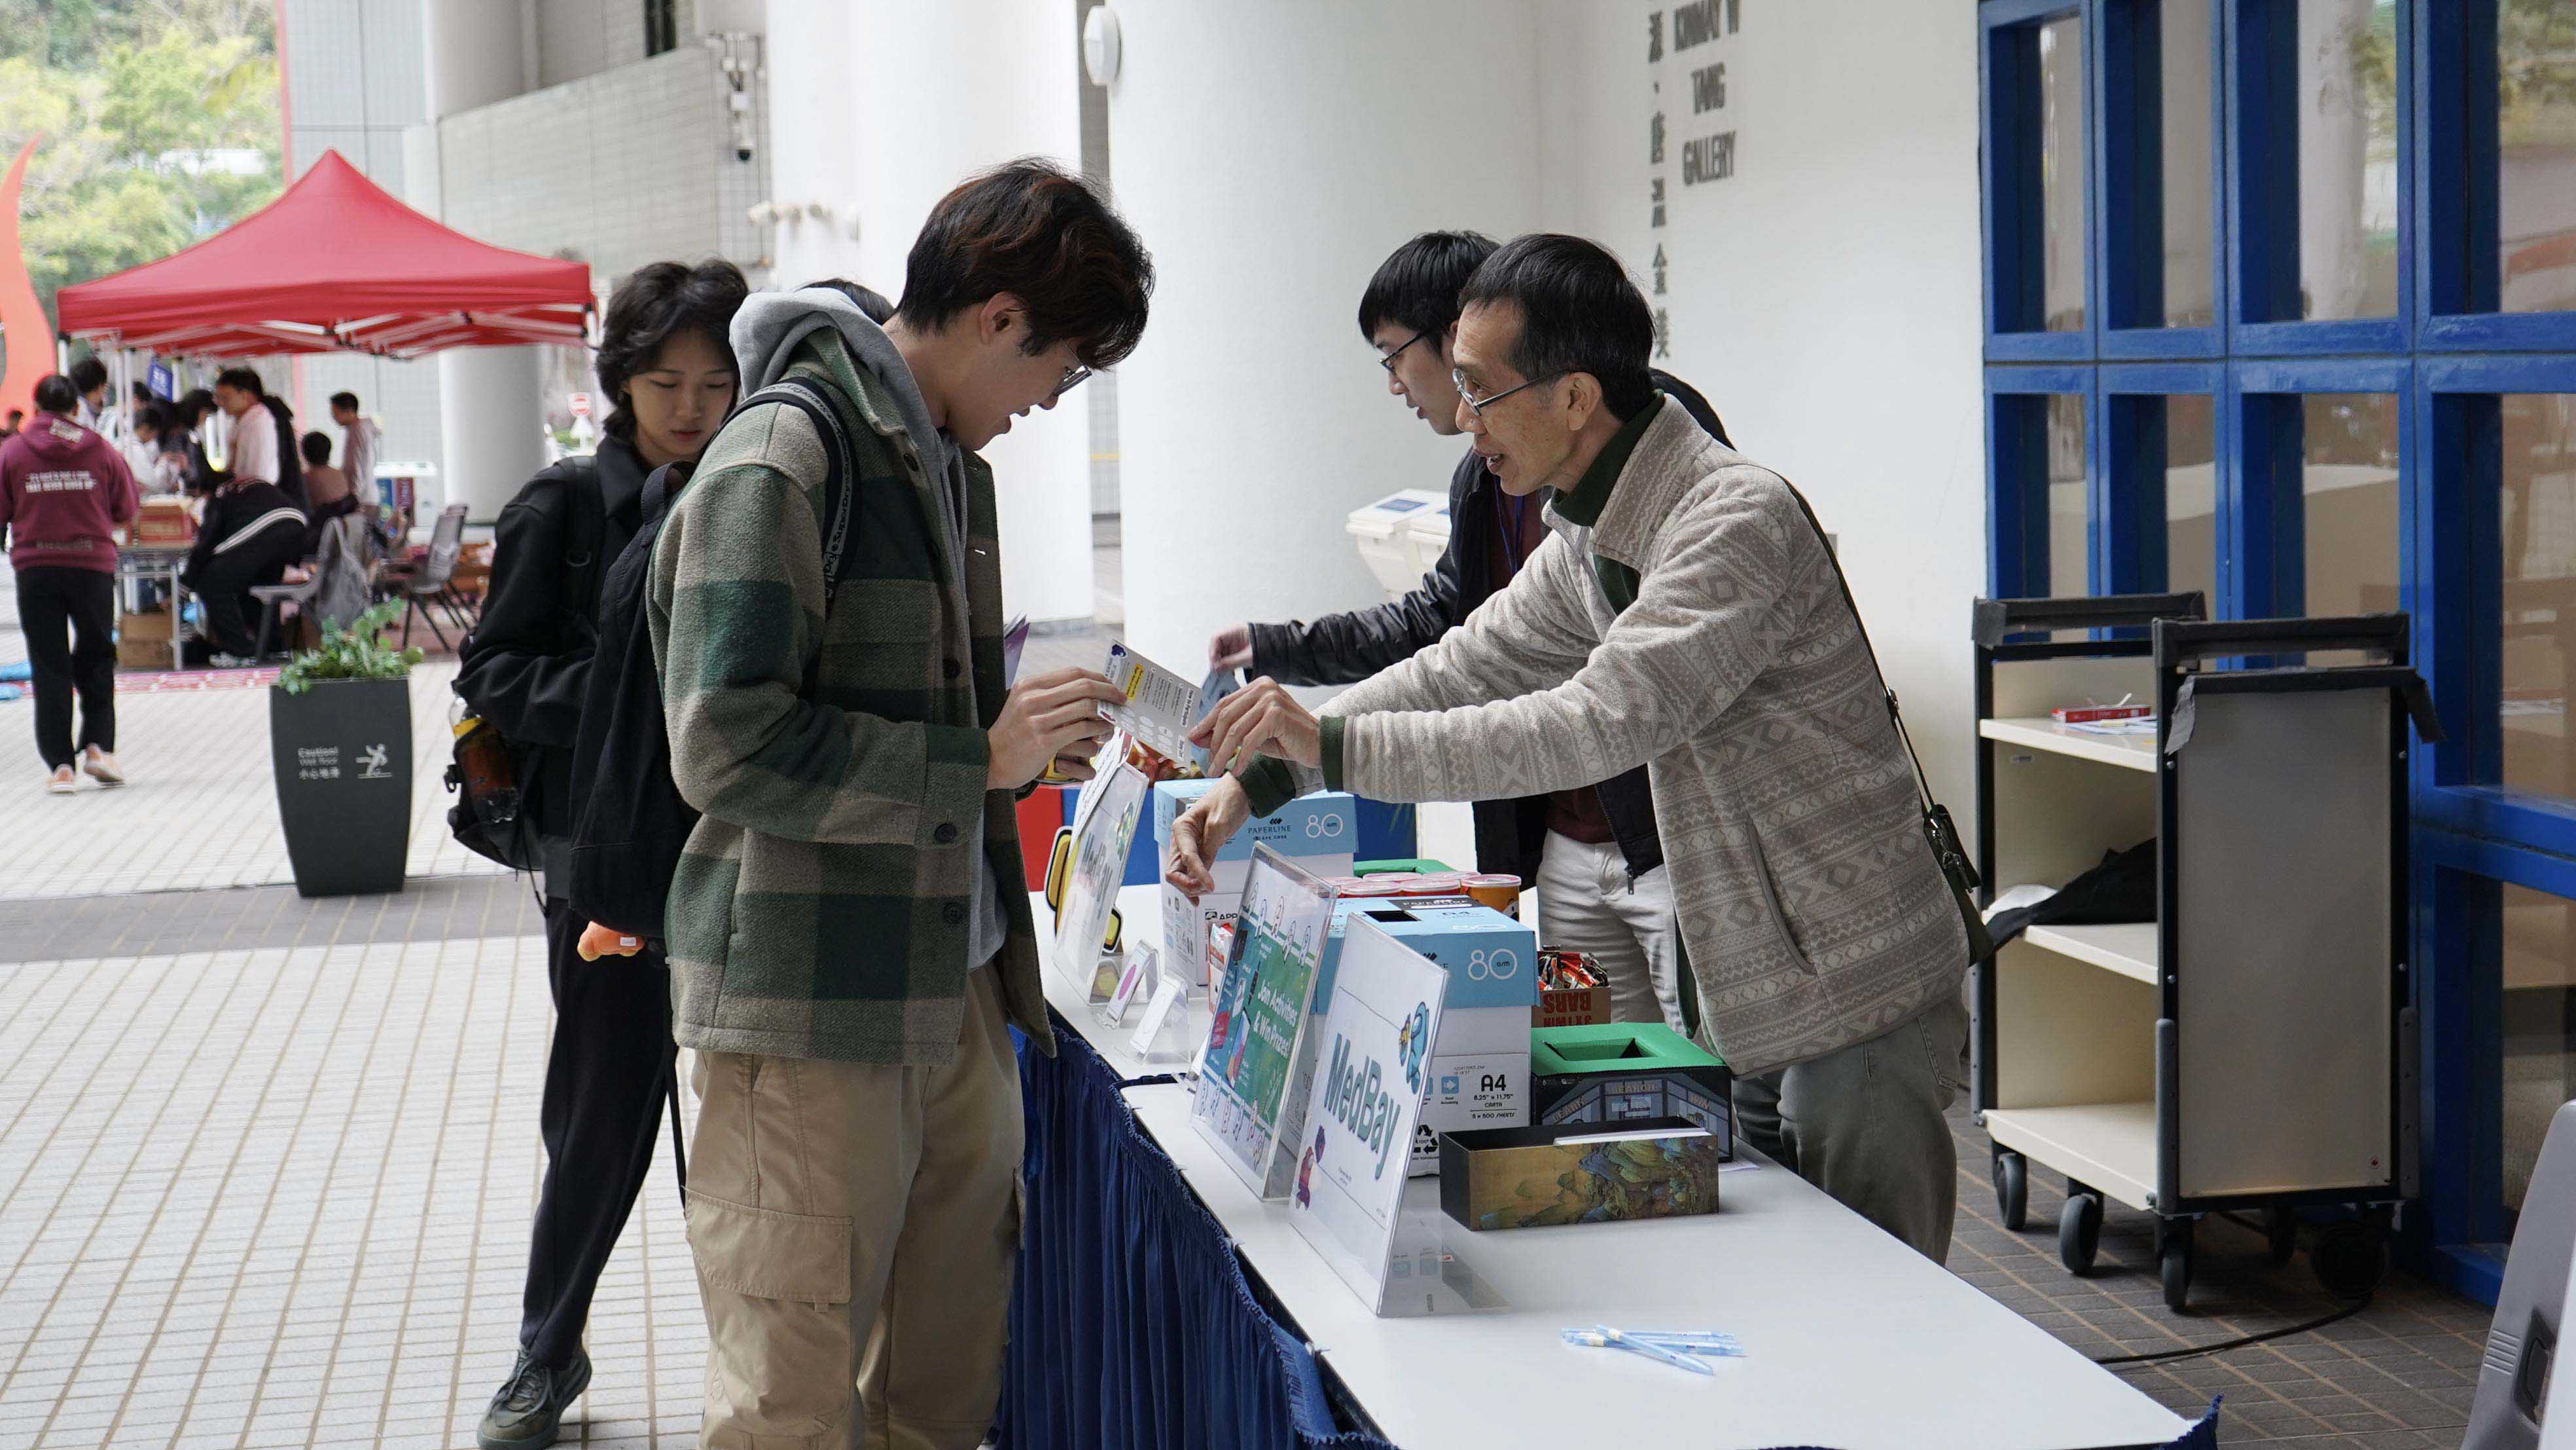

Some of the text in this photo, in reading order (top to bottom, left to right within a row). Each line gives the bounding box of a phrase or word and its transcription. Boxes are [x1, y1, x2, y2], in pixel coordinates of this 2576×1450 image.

[1690, 62, 1726, 115] TANG
[1683, 131, 1736, 186] GALLERY
[1247, 813, 1343, 838] PAPERLINE 80
[1467, 948, 1518, 981] 80
[1269, 989, 1298, 1027] Activities
[1543, 991, 1592, 1014] BARS
[1481, 1074, 1507, 1092] A4
[1323, 1032, 1401, 1180] MedBay
